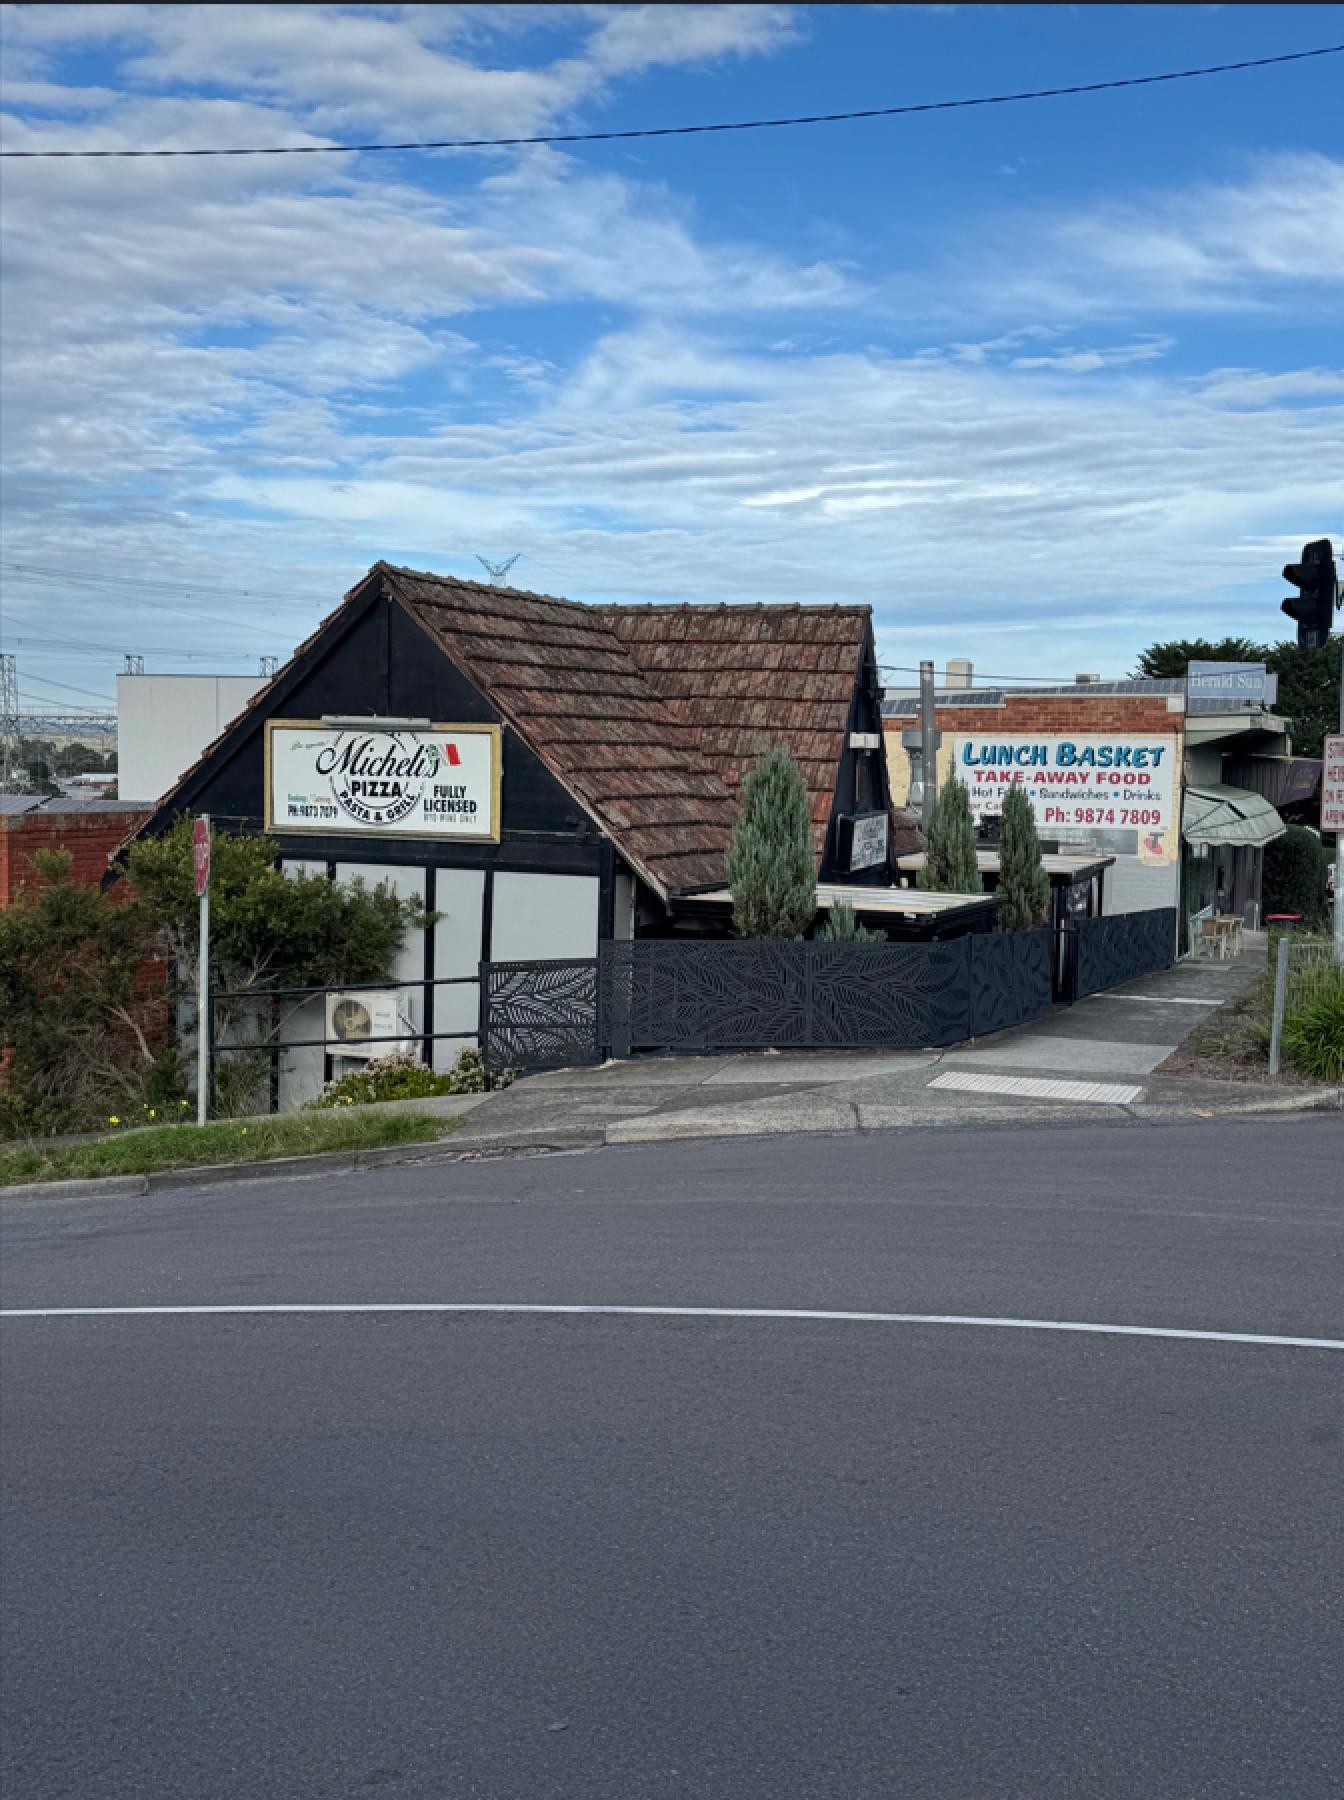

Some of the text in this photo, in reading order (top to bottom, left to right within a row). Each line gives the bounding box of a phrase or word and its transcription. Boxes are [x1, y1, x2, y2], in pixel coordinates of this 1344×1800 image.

[1191, 672, 1263, 689] Herald Sun
[963, 742, 1165, 768] LUNCH BASKET
[974, 770, 1151, 785] TAKE-AWAY FOOD
[351, 781, 401, 797] PIZZA
[433, 785, 467, 799] FULLY
[1039, 787, 1109, 801] Sandwiches
[1123, 789, 1162, 801] Drinks
[424, 798, 477, 813] LICENSED
[1045, 806, 1161, 825] Ph: 9874 7809
